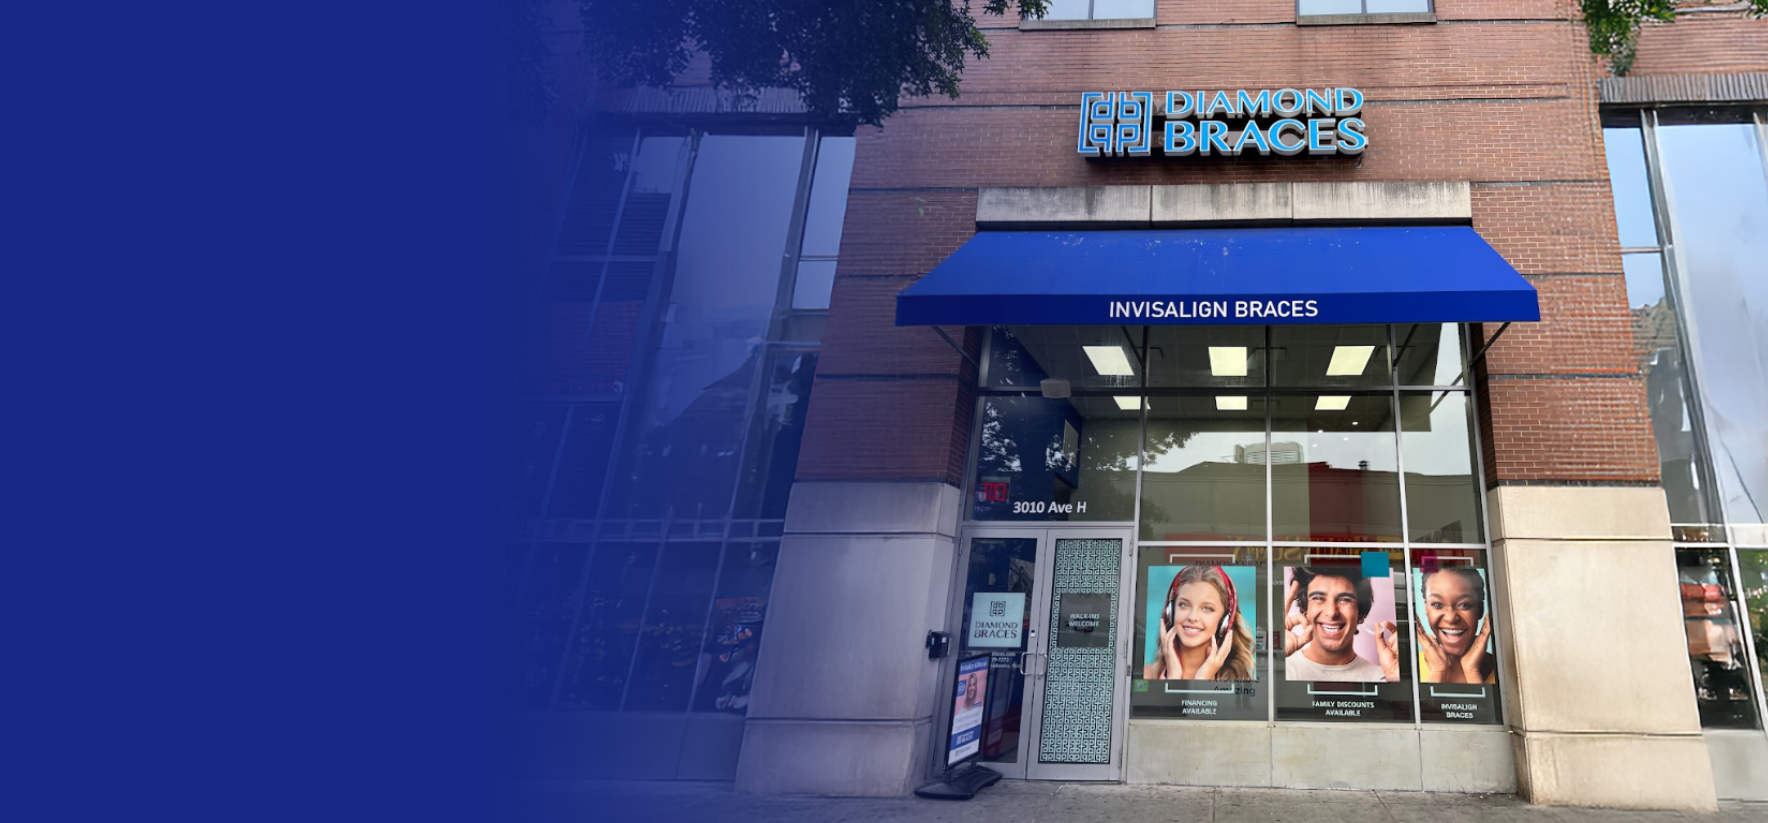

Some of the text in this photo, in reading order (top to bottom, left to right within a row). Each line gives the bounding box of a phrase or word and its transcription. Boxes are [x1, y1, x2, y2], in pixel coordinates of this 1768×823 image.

[1165, 87, 1364, 118] DIAMOND
[1163, 118, 1367, 156] BRACES
[1109, 300, 1318, 318] INVISALIGN BRACES
[1012, 501, 1087, 514] 3010 Ave H
[974, 621, 1018, 629] DIAMOND
[974, 629, 1018, 639] BRACES
[1312, 700, 1375, 709] FAMILY DISCOUNTS
[1441, 703, 1478, 711] INVISALIGN
[1325, 709, 1361, 717] AVAILABLE
[1446, 711, 1474, 719] BRACES
